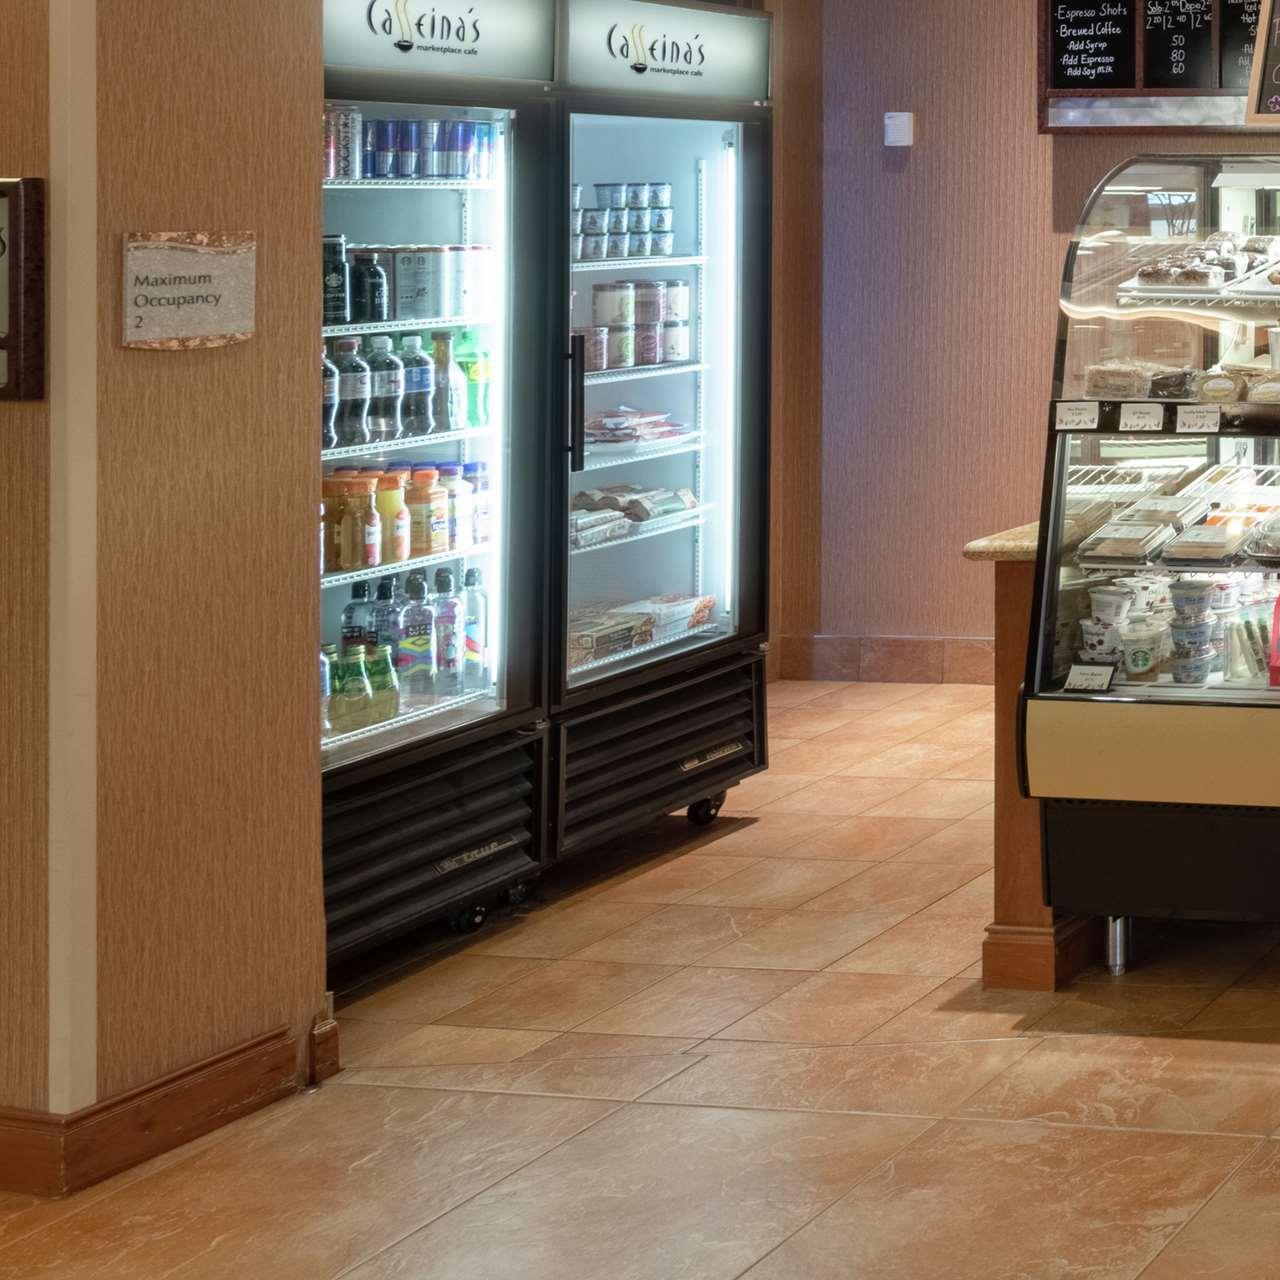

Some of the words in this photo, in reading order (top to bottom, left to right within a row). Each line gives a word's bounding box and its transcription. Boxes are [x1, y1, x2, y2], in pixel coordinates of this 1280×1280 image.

[1058, 5, 1096, 22] Espresso
[1099, 2, 1127, 17] Shots
[1060, 23, 1094, 37] Brewed
[1095, 22, 1121, 35] Coffee
[416, 44, 461, 55] marketplace
[463, 46, 478, 55] cafe
[1069, 41, 1084, 51] Add
[1085, 40, 1107, 53] Syrup
[1062, 55, 1078, 66] Add
[1080, 54, 1115, 67] Espresso
[649, 67, 689, 77] marketplace
[1067, 67, 1082, 77] Add
[1082, 67, 1096, 80] Soy
[133, 272, 213, 288] Maximum
[133, 291, 222, 310] Occupancy
[135, 315, 144, 329] 2
